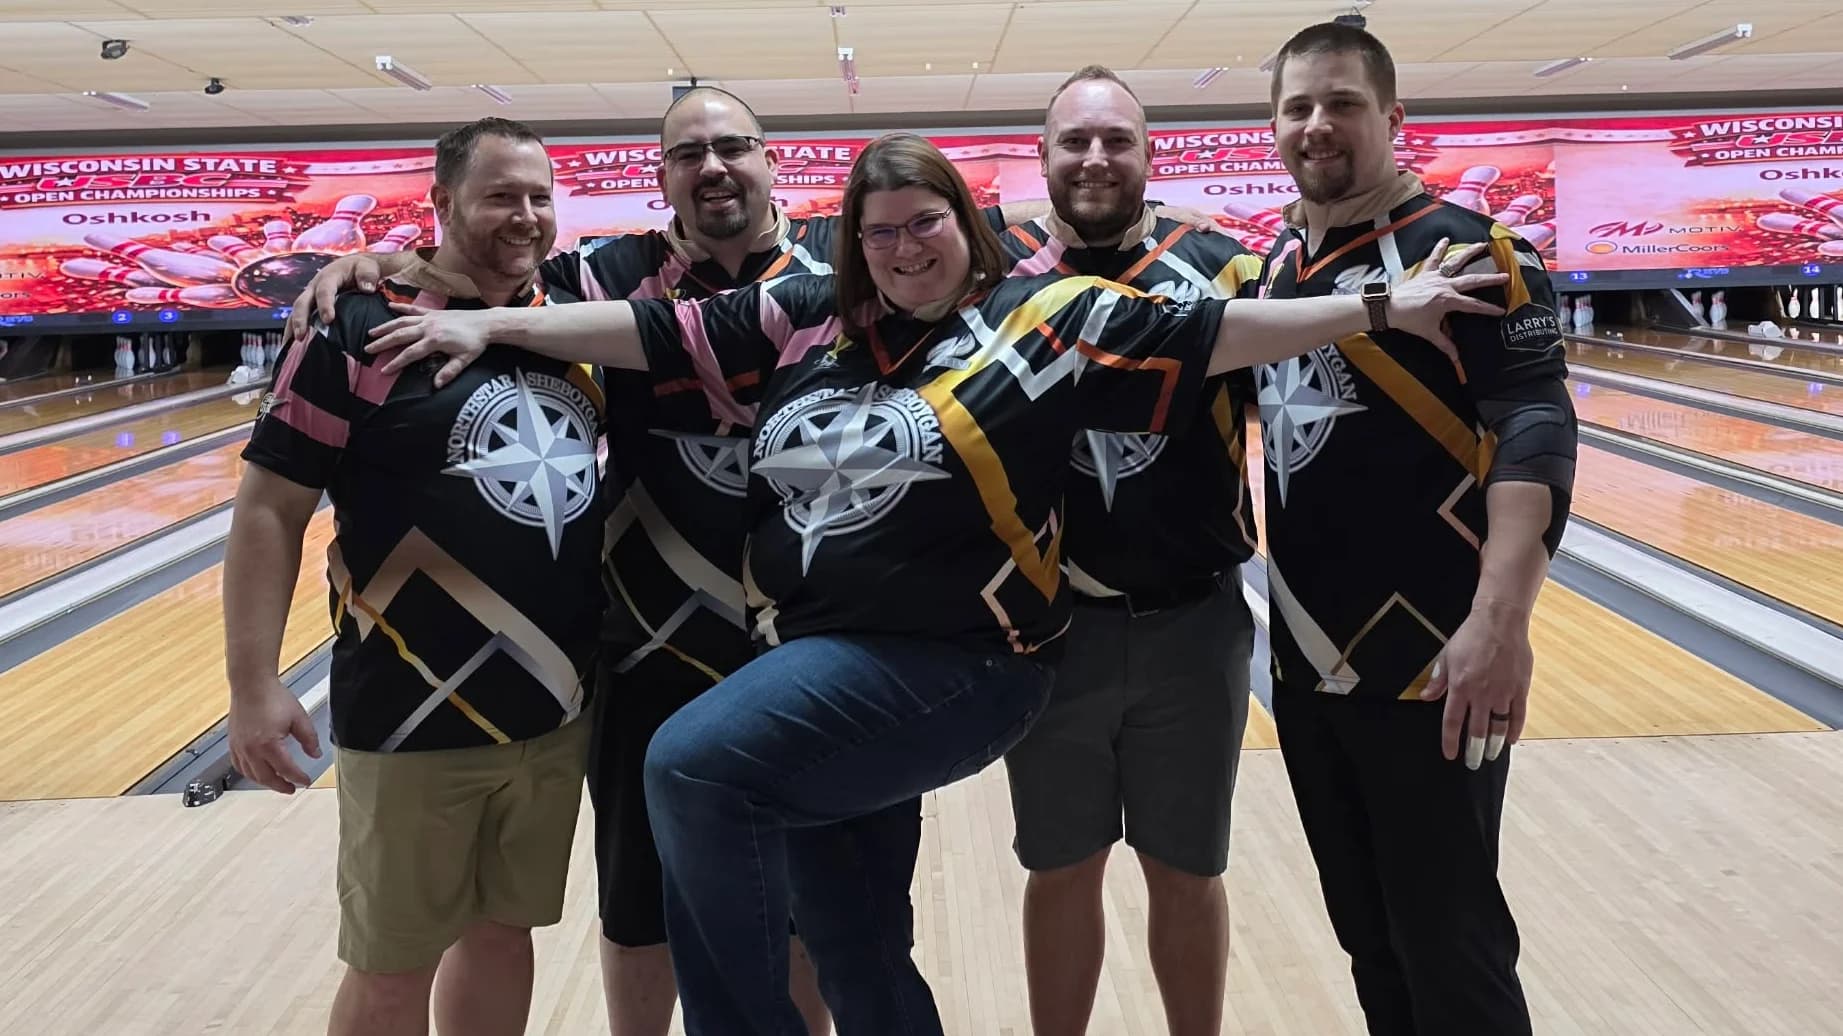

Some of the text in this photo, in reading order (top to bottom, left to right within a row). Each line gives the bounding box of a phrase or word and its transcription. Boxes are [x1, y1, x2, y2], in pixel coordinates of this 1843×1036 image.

[1154, 131, 1276, 151] WISCONS
[768, 146, 851, 160] TATE
[1714, 148, 1771, 160] OPEN
[0, 157, 277, 179] WISCONSIN STATE
[1159, 163, 1215, 175] OPEN
[1759, 167, 1843, 181] Oshk
[600, 177, 659, 189] OPEN
[1202, 182, 1299, 196] Oshko
[14, 187, 261, 203] OPEN CHAMPIONSHIPS
[62, 210, 211, 225] Oshkosh
[1622, 243, 1729, 254] MillerCoors
[1507, 316, 1557, 335] LARRY'S
[446, 371, 599, 464] NORTHSTAR SHEBOYGA
